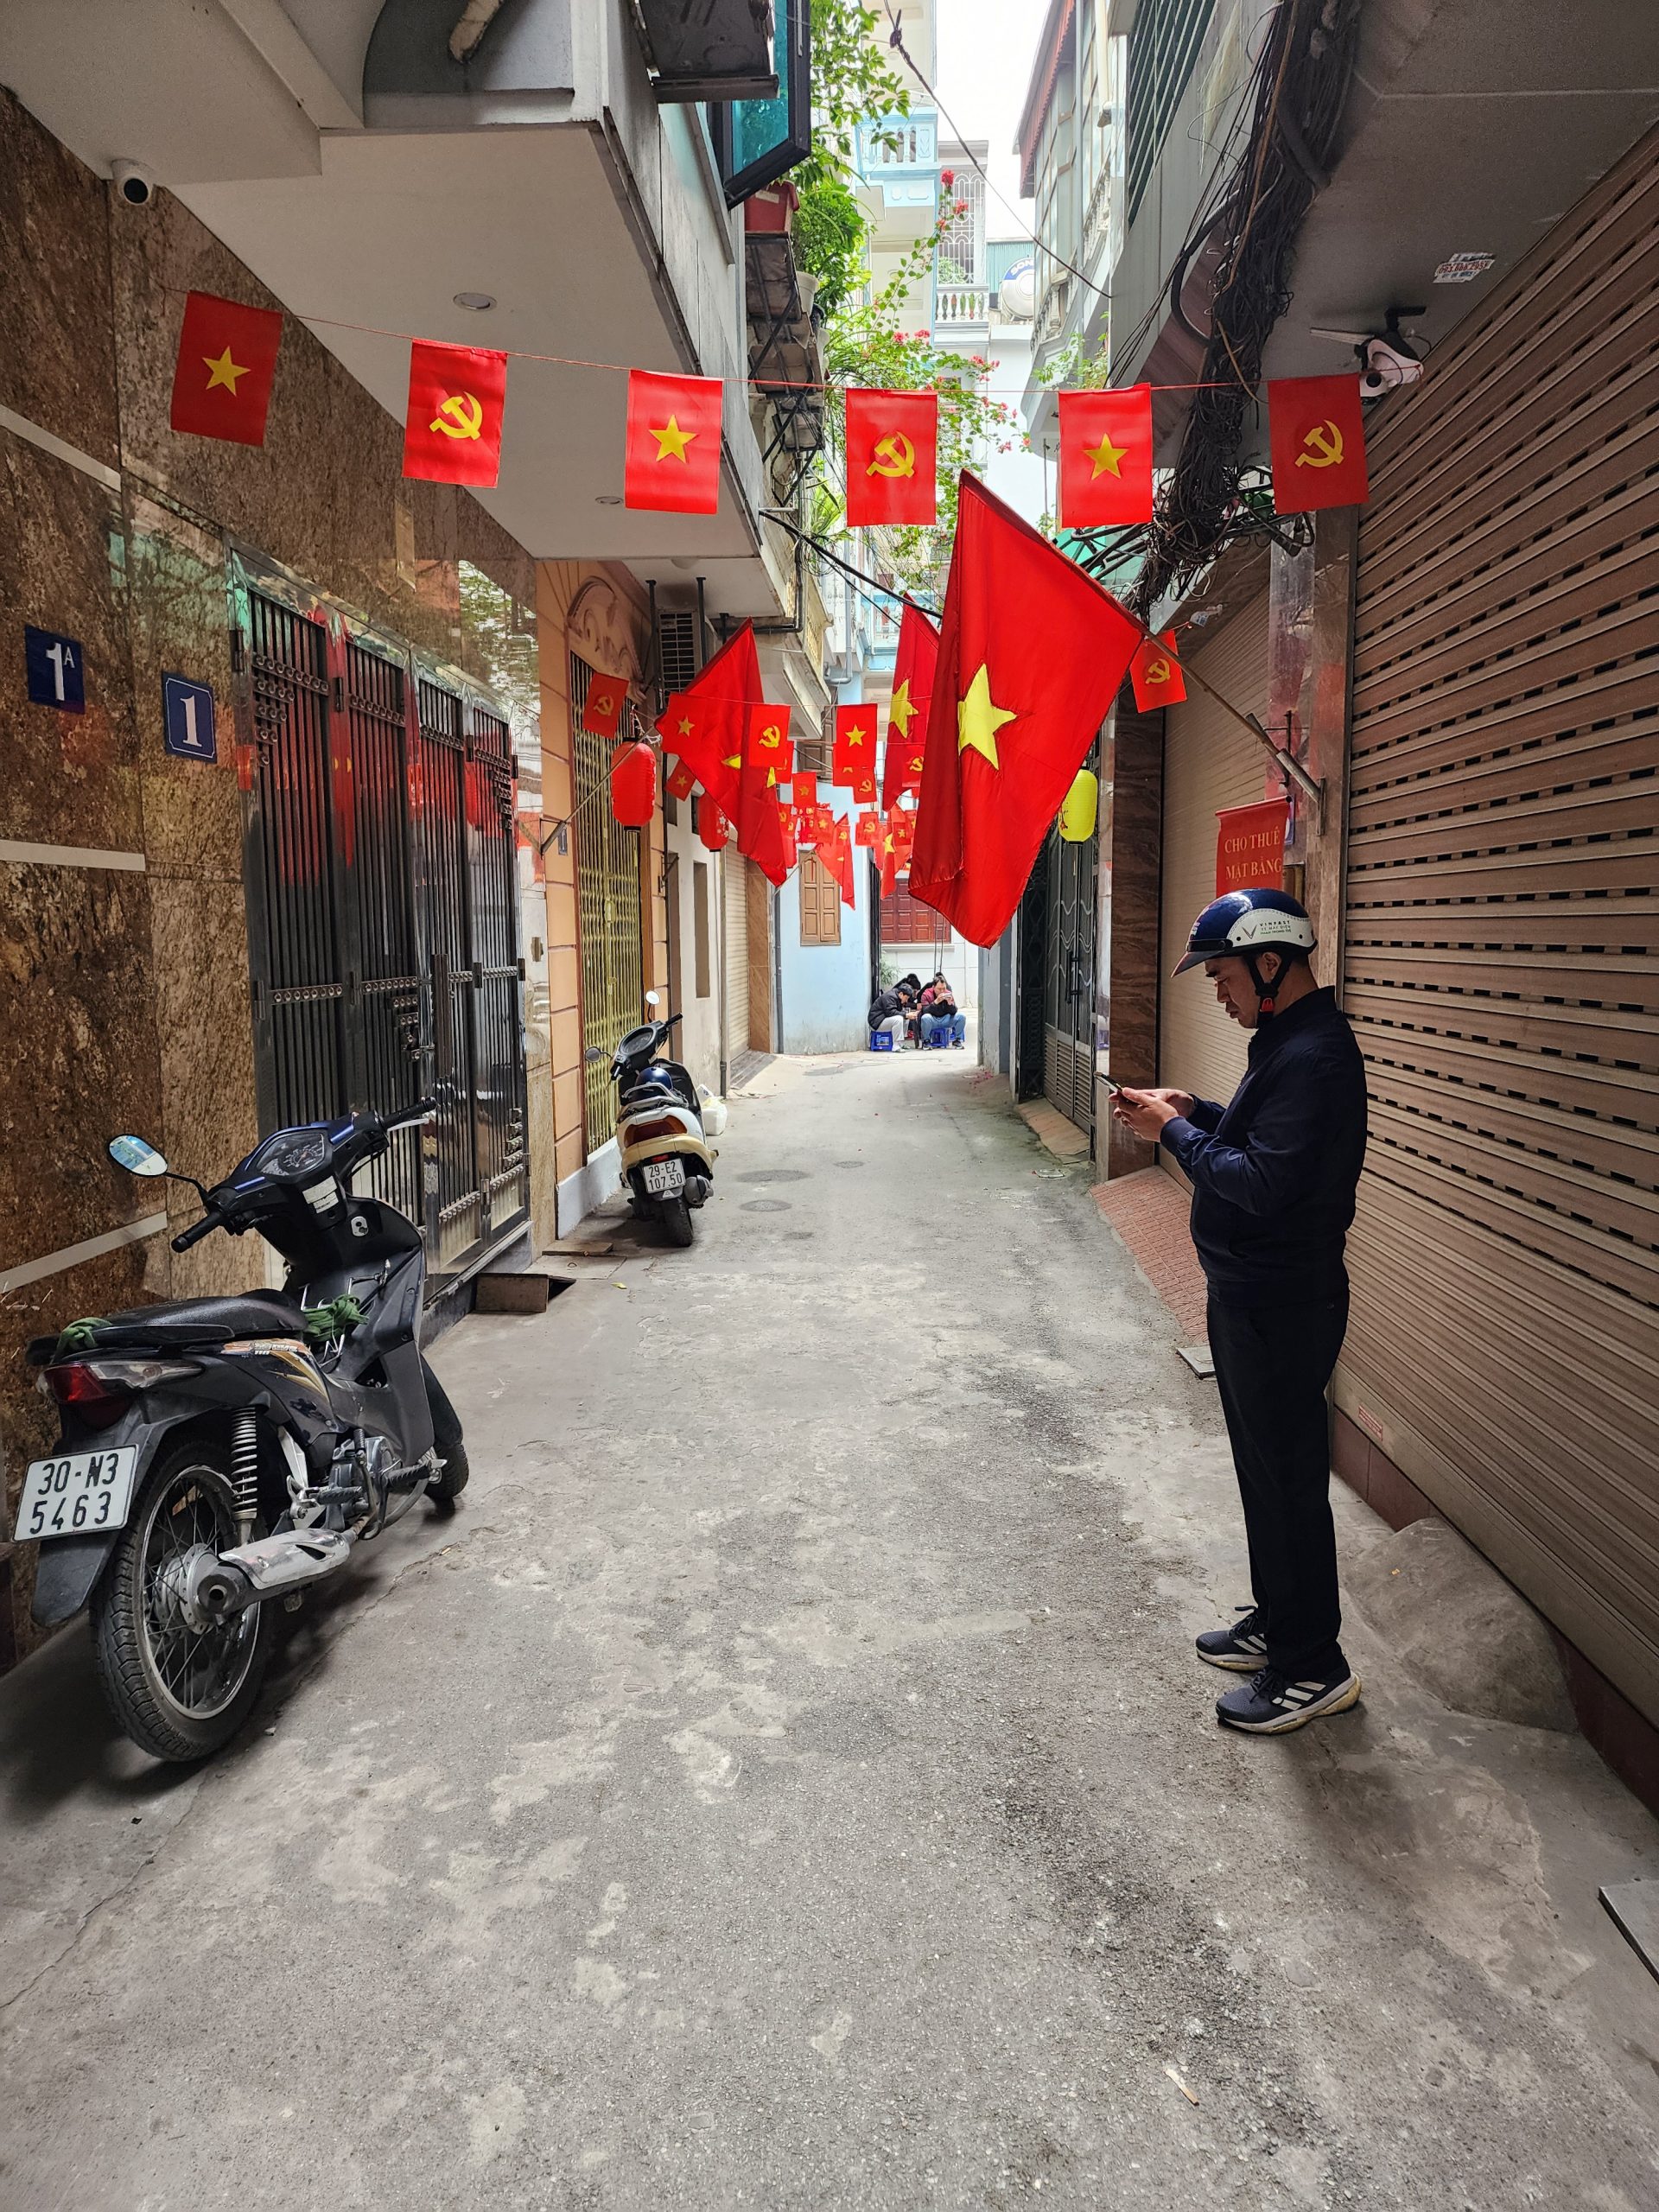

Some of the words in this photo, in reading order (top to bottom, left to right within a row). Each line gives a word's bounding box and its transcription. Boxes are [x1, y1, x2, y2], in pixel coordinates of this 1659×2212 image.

[46, 642, 75, 701] 1A
[180, 695, 202, 747] 1
[1224, 836, 1247, 853] CHO
[1249, 826, 1281, 849] THUÊ
[649, 1161, 677, 1178] 29-E2
[649, 1173, 683, 1191] 107.50
[37, 1452, 119, 1496] 30-N3
[29, 1491, 111, 1535] 5463
